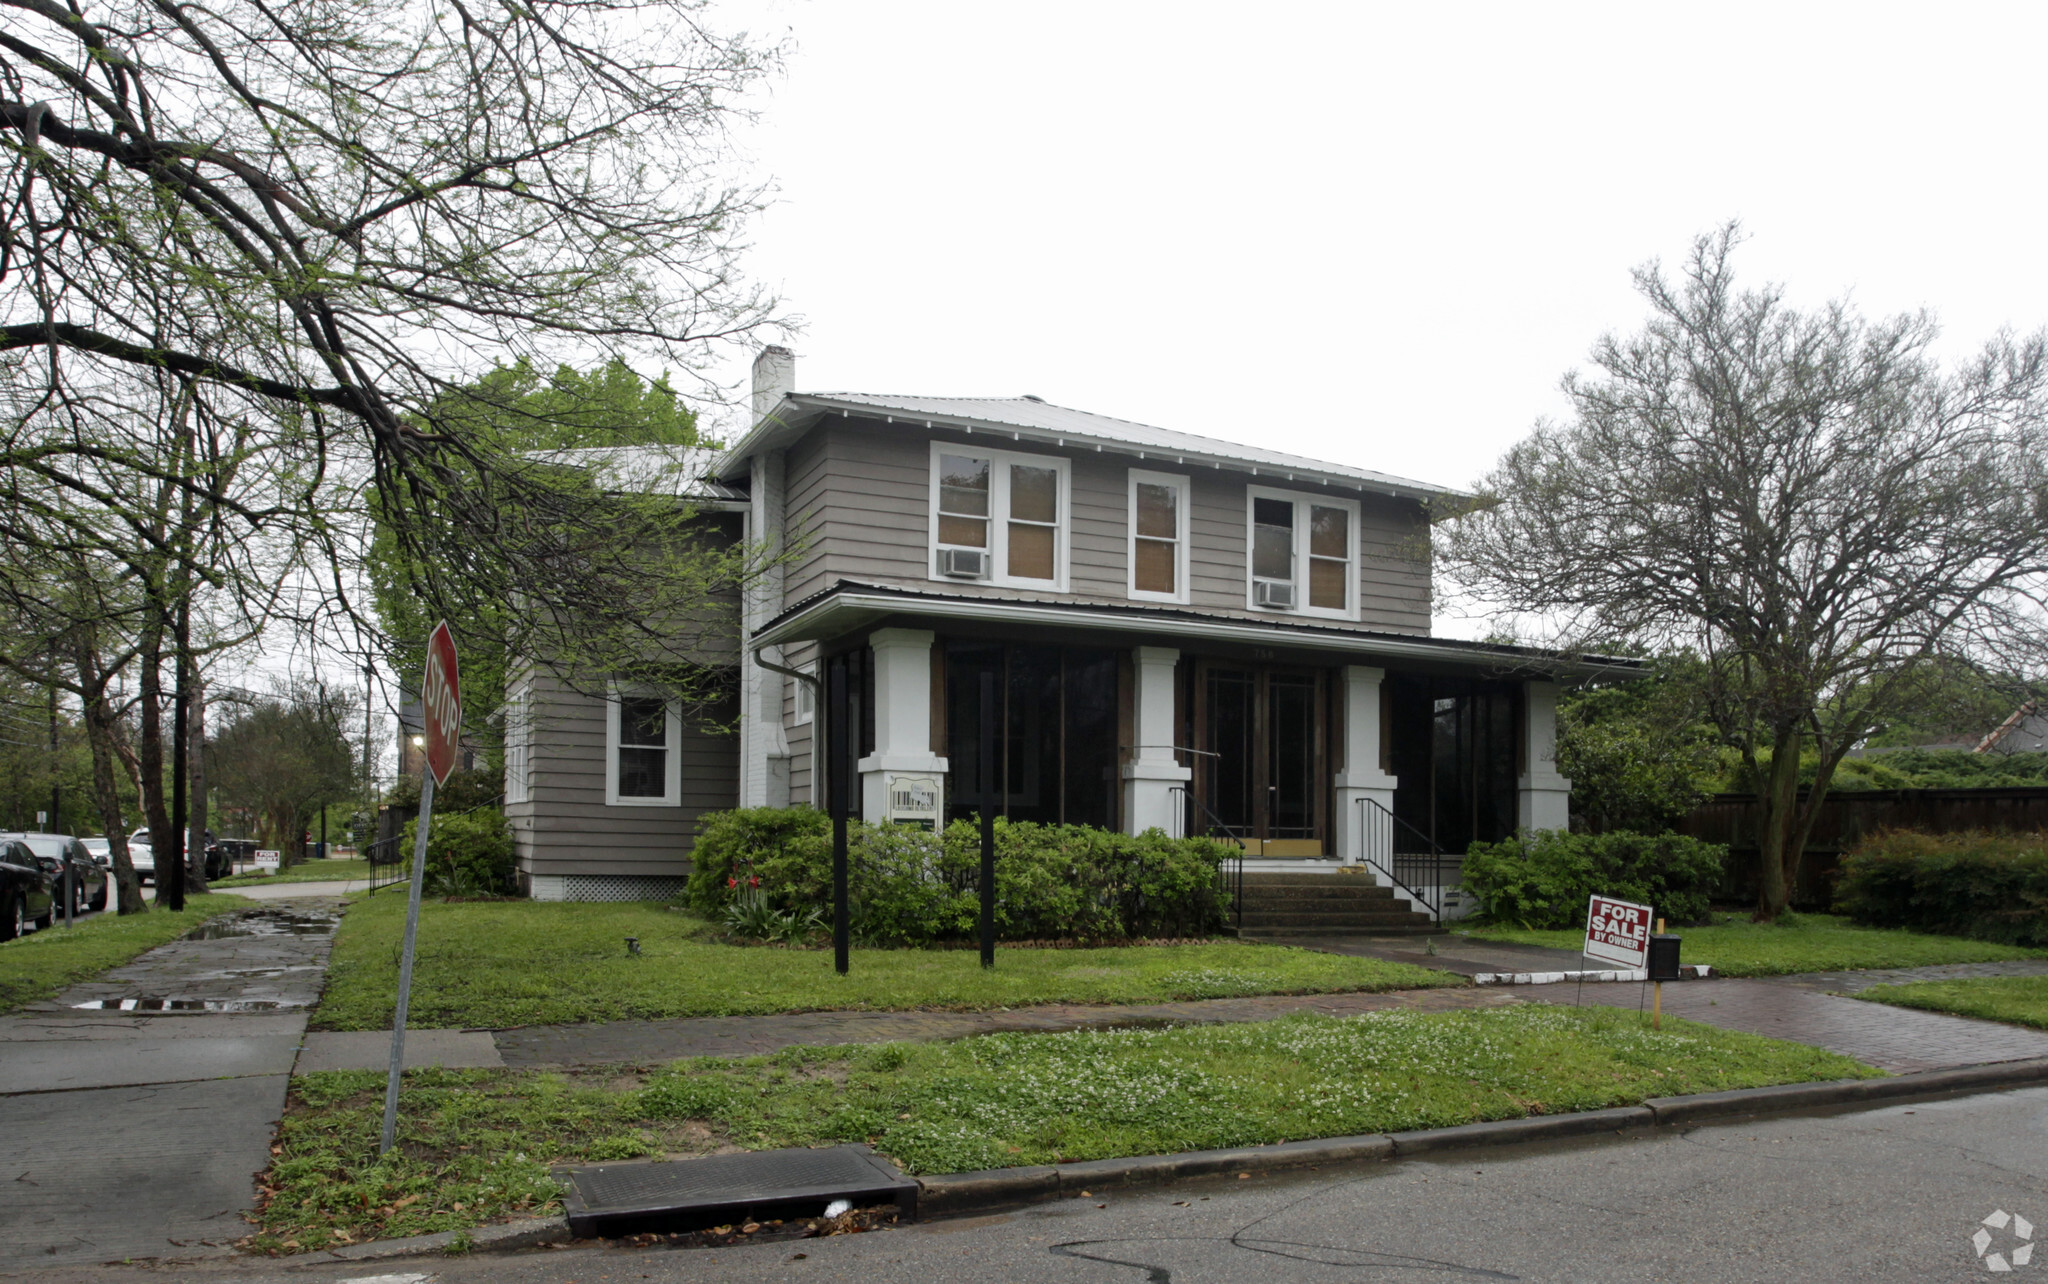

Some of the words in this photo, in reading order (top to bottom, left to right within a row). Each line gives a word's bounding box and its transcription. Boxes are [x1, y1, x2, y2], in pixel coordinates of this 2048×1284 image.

[427, 653, 458, 746] STOP
[1600, 903, 1639, 923] FOR
[1591, 915, 1646, 941] SALE
[1594, 931, 1607, 941] BY
[1608, 934, 1638, 949] OWNER
